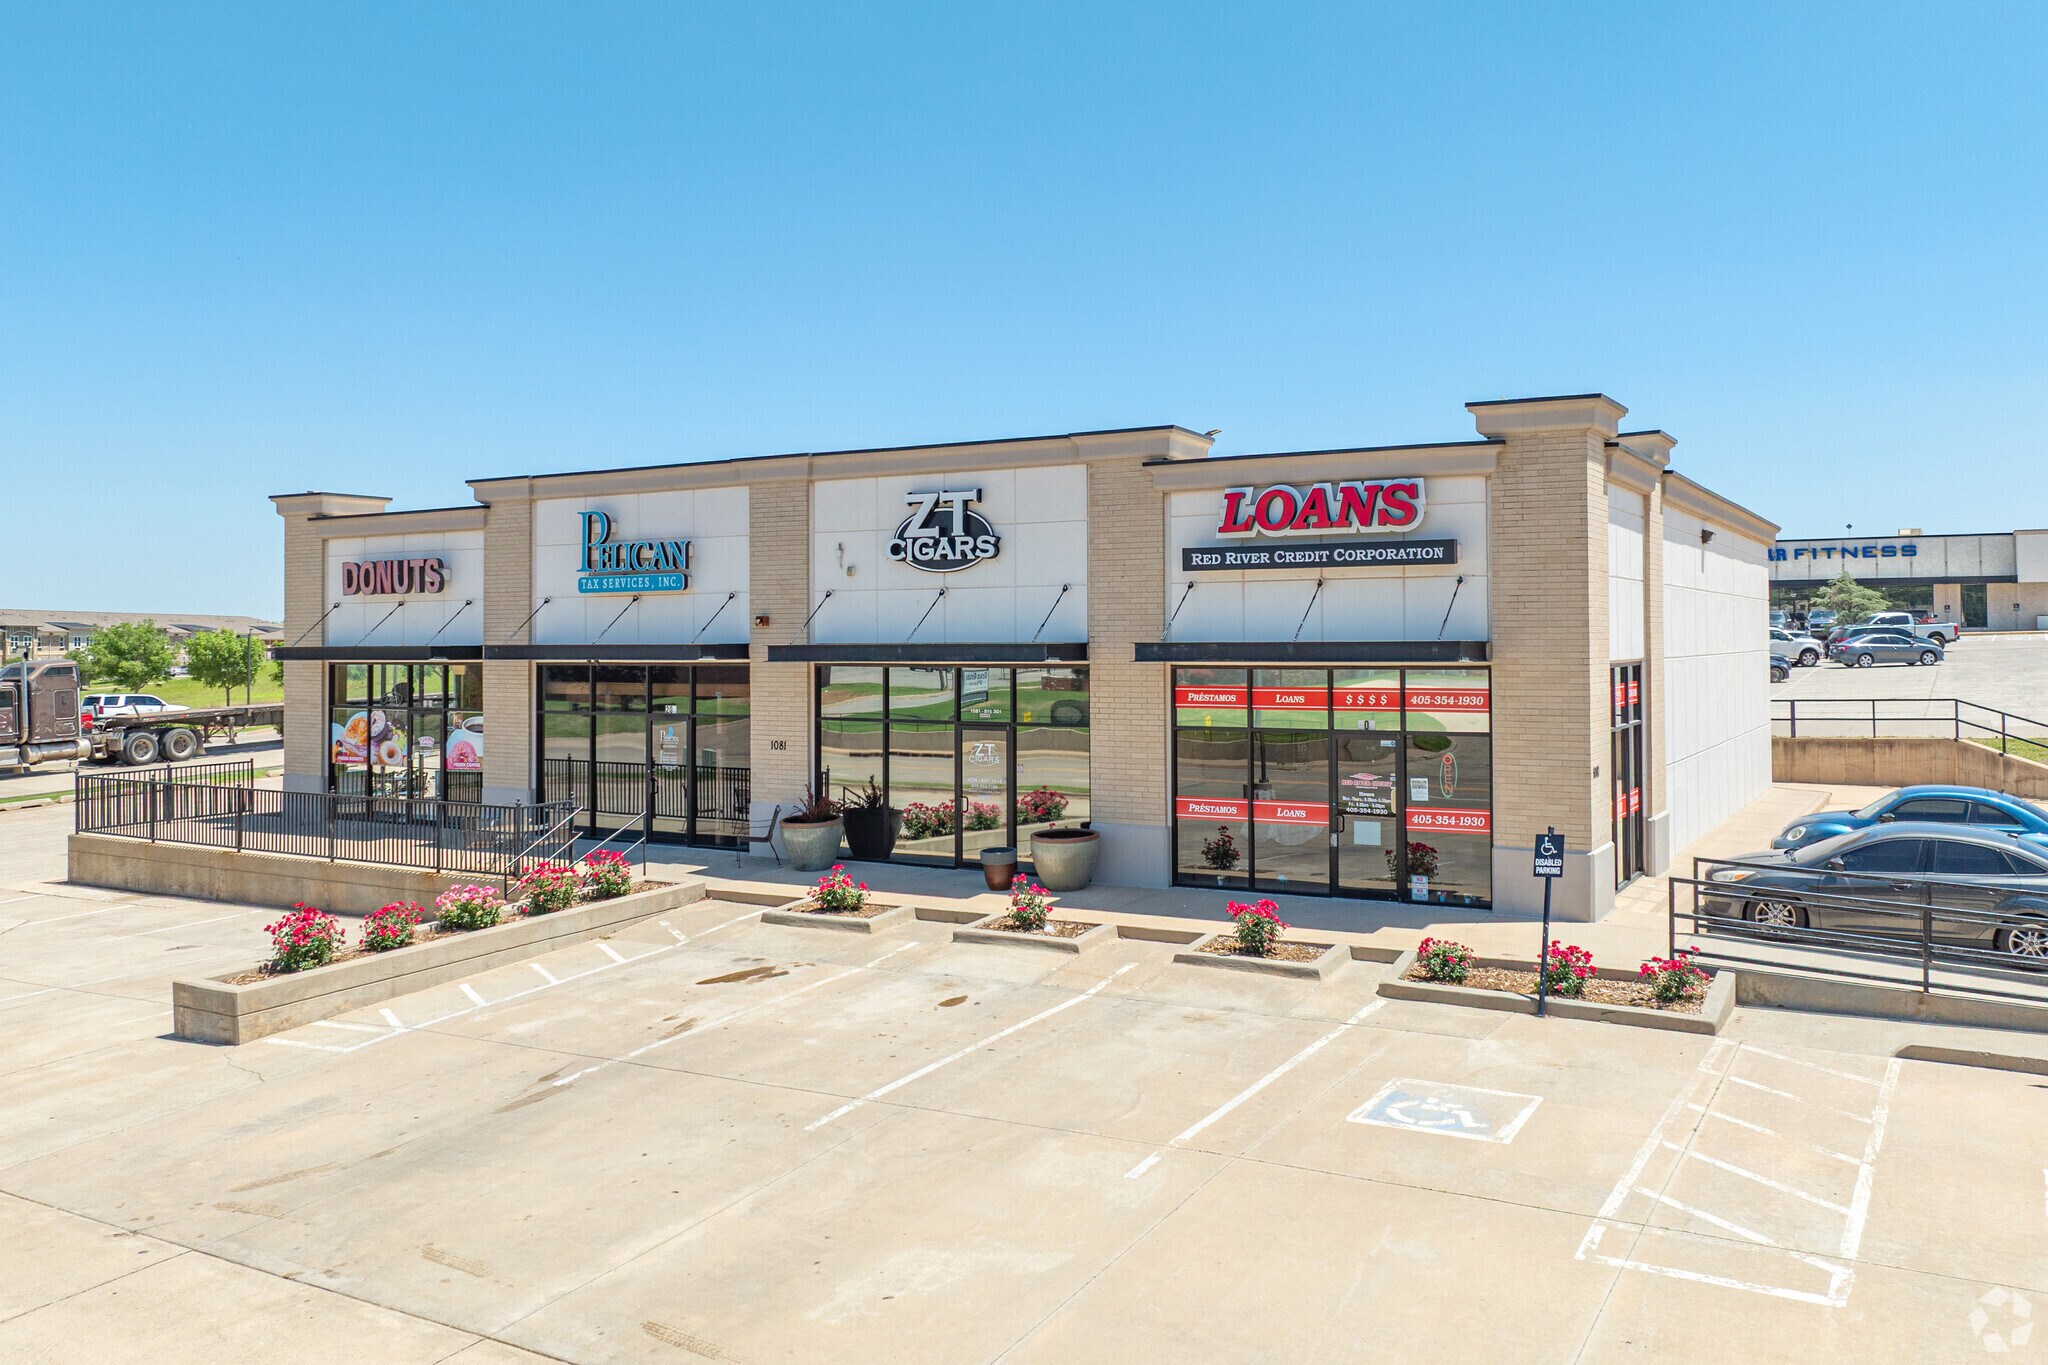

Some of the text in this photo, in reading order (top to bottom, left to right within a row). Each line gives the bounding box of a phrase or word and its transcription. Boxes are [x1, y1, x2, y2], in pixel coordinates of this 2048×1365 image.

[903, 488, 982, 538] ZT
[1217, 482, 1420, 534] LOANS
[576, 510, 691, 573] PELICAN
[885, 534, 1000, 562] CIGARS
[1793, 544, 1918, 561] FITNESS
[1191, 547, 1445, 565] RED RIVER CREDIT CORPORATION
[342, 557, 445, 597] DONUTS
[581, 576, 681, 589] TAX SERVICES, INC.
[1187, 692, 1237, 702] PRÉSTAMOS
[1275, 694, 1306, 703] LOANS
[1410, 695, 1484, 706] 405-354-1930
[770, 740, 787, 750] 1081
[974, 743, 996, 756] ZT
[968, 755, 1000, 764] CIGARS
[1442, 753, 1454, 794] OPEN
[1188, 803, 1237, 814] PRÉSTAMOS
[1276, 807, 1306, 818] LOANS
[1411, 815, 1485, 827] 405-354-1930
[1535, 858, 1562, 867] DISABLED
[1535, 866, 1561, 875] PARKING
